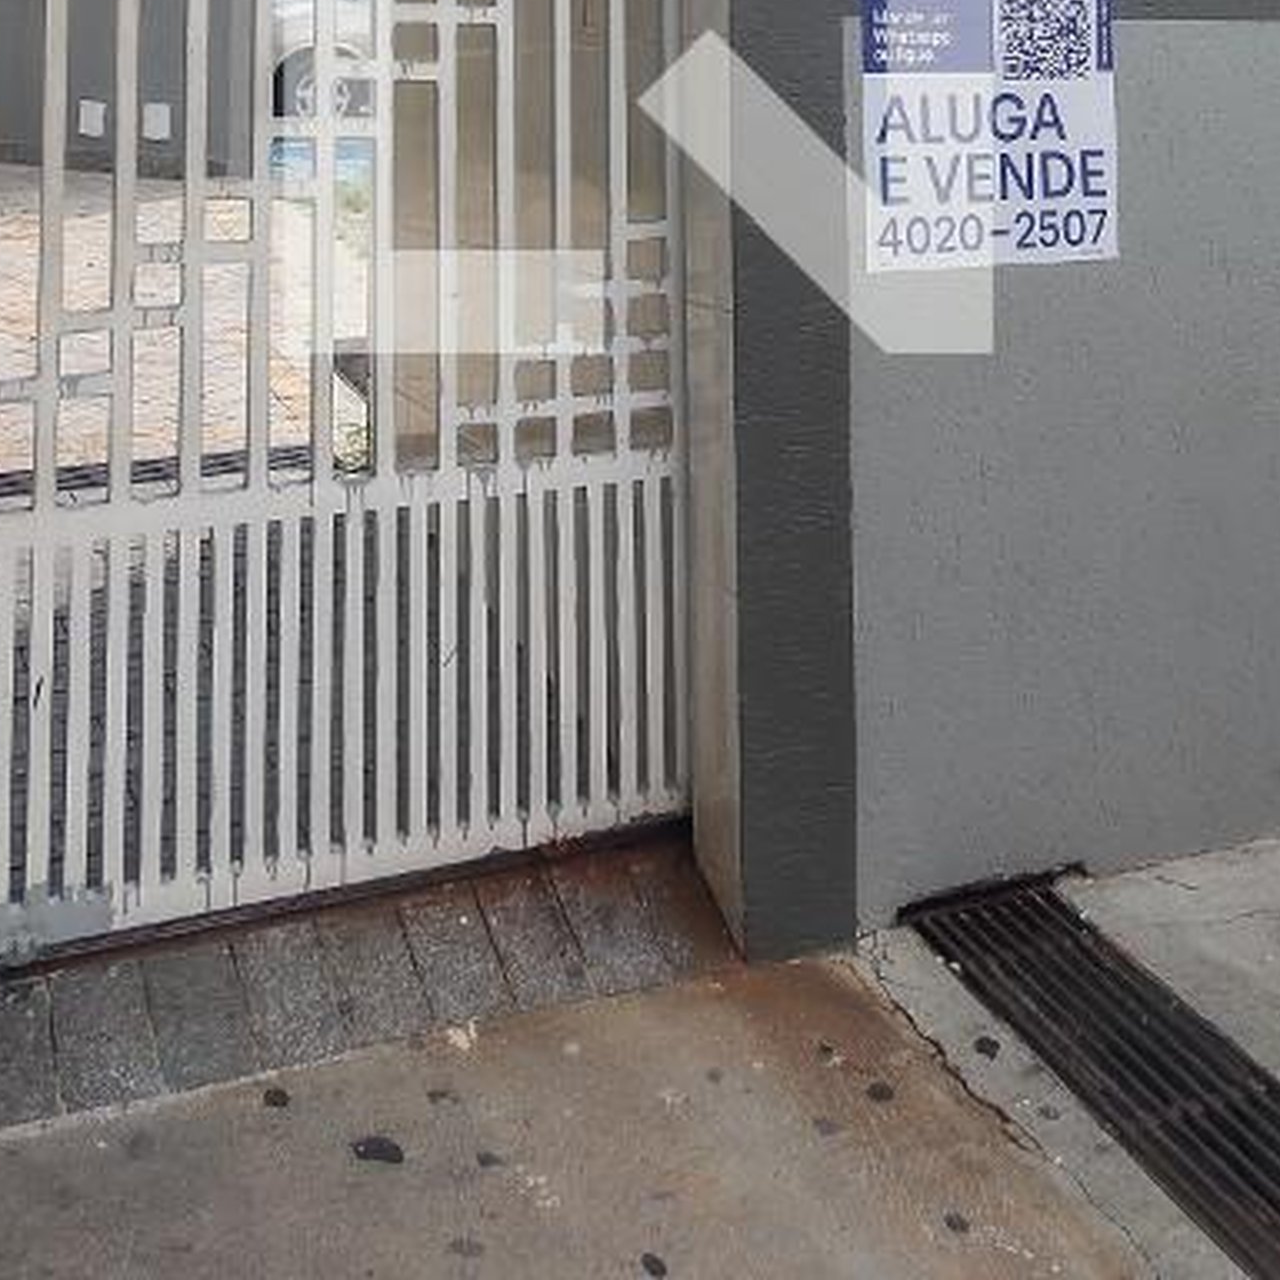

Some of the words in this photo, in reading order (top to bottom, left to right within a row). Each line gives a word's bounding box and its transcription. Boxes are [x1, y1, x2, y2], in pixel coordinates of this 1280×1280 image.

[875, 93, 1066, 144] ALUGA
[880, 156, 909, 206] E
[925, 150, 1107, 204] VENDE
[878, 210, 1109, 256] 4020-2507
